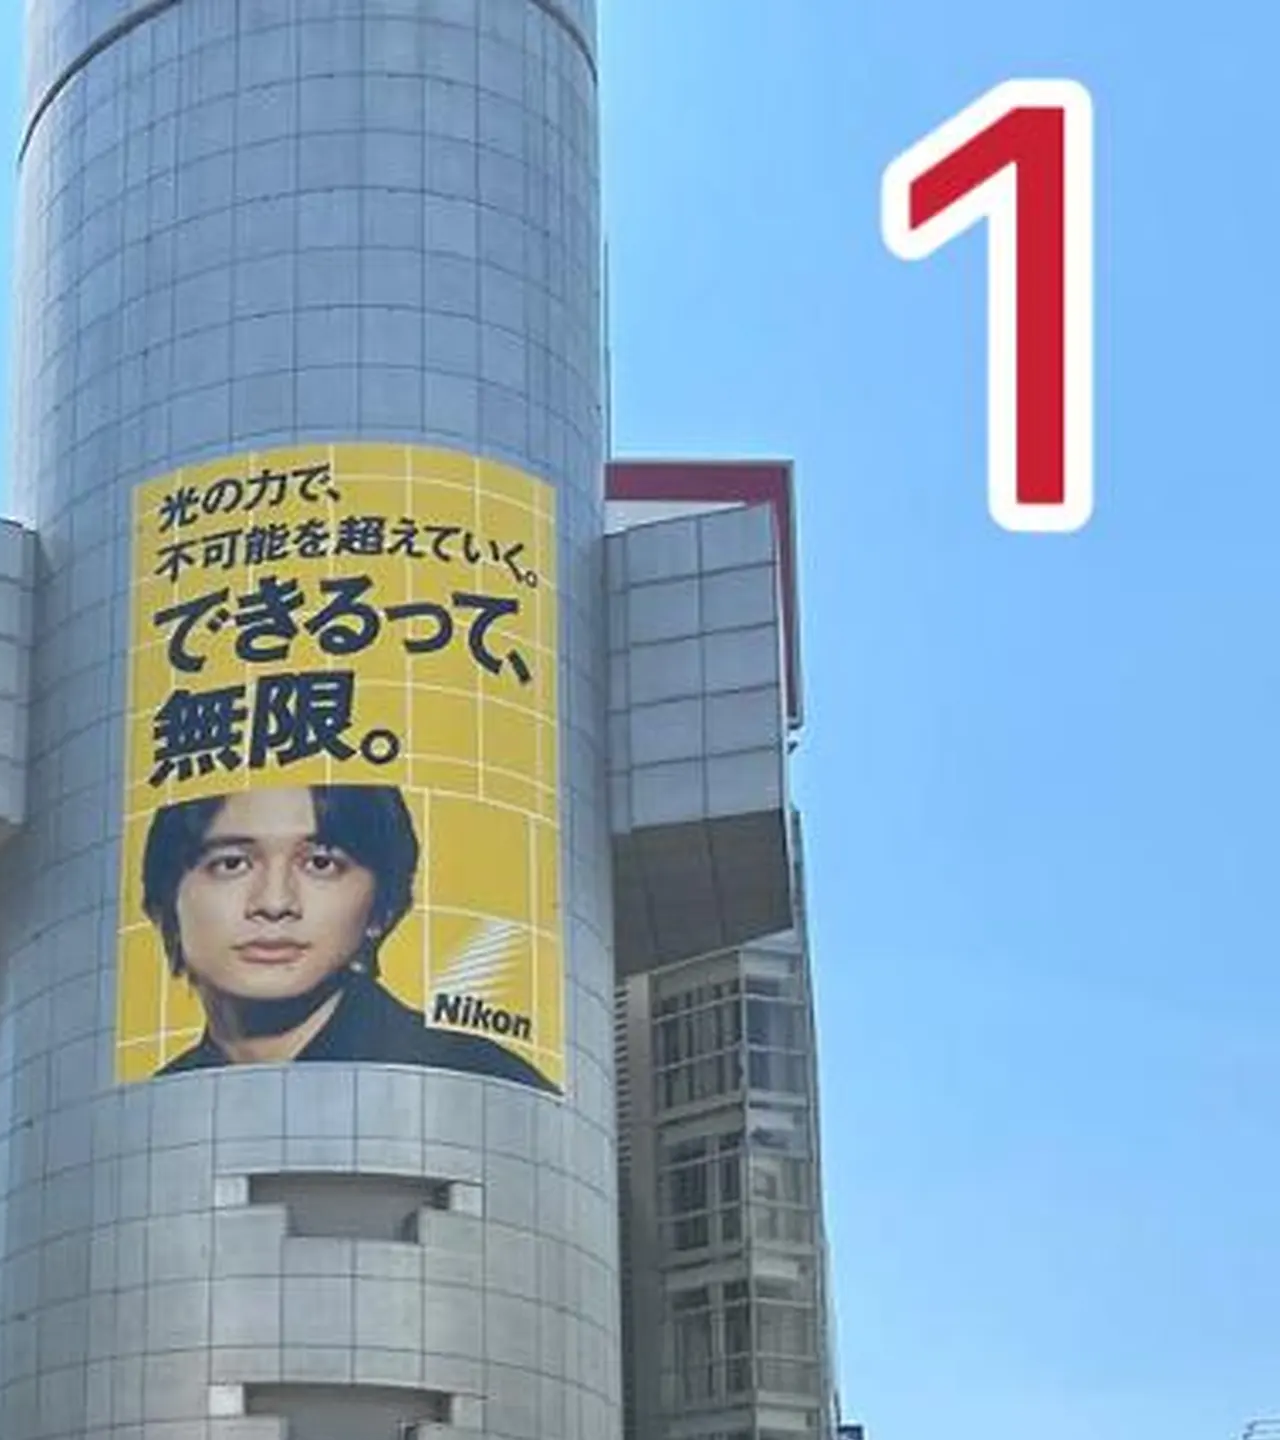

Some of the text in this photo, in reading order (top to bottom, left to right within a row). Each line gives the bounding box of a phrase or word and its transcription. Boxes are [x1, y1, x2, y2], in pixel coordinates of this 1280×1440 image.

[157, 461, 343, 532] 光の力で、
[153, 514, 539, 589] 不可能を超えていく。
[152, 574, 534, 684] できるって、
[148, 669, 402, 788] 無限。
[432, 993, 532, 1041] Nikon
